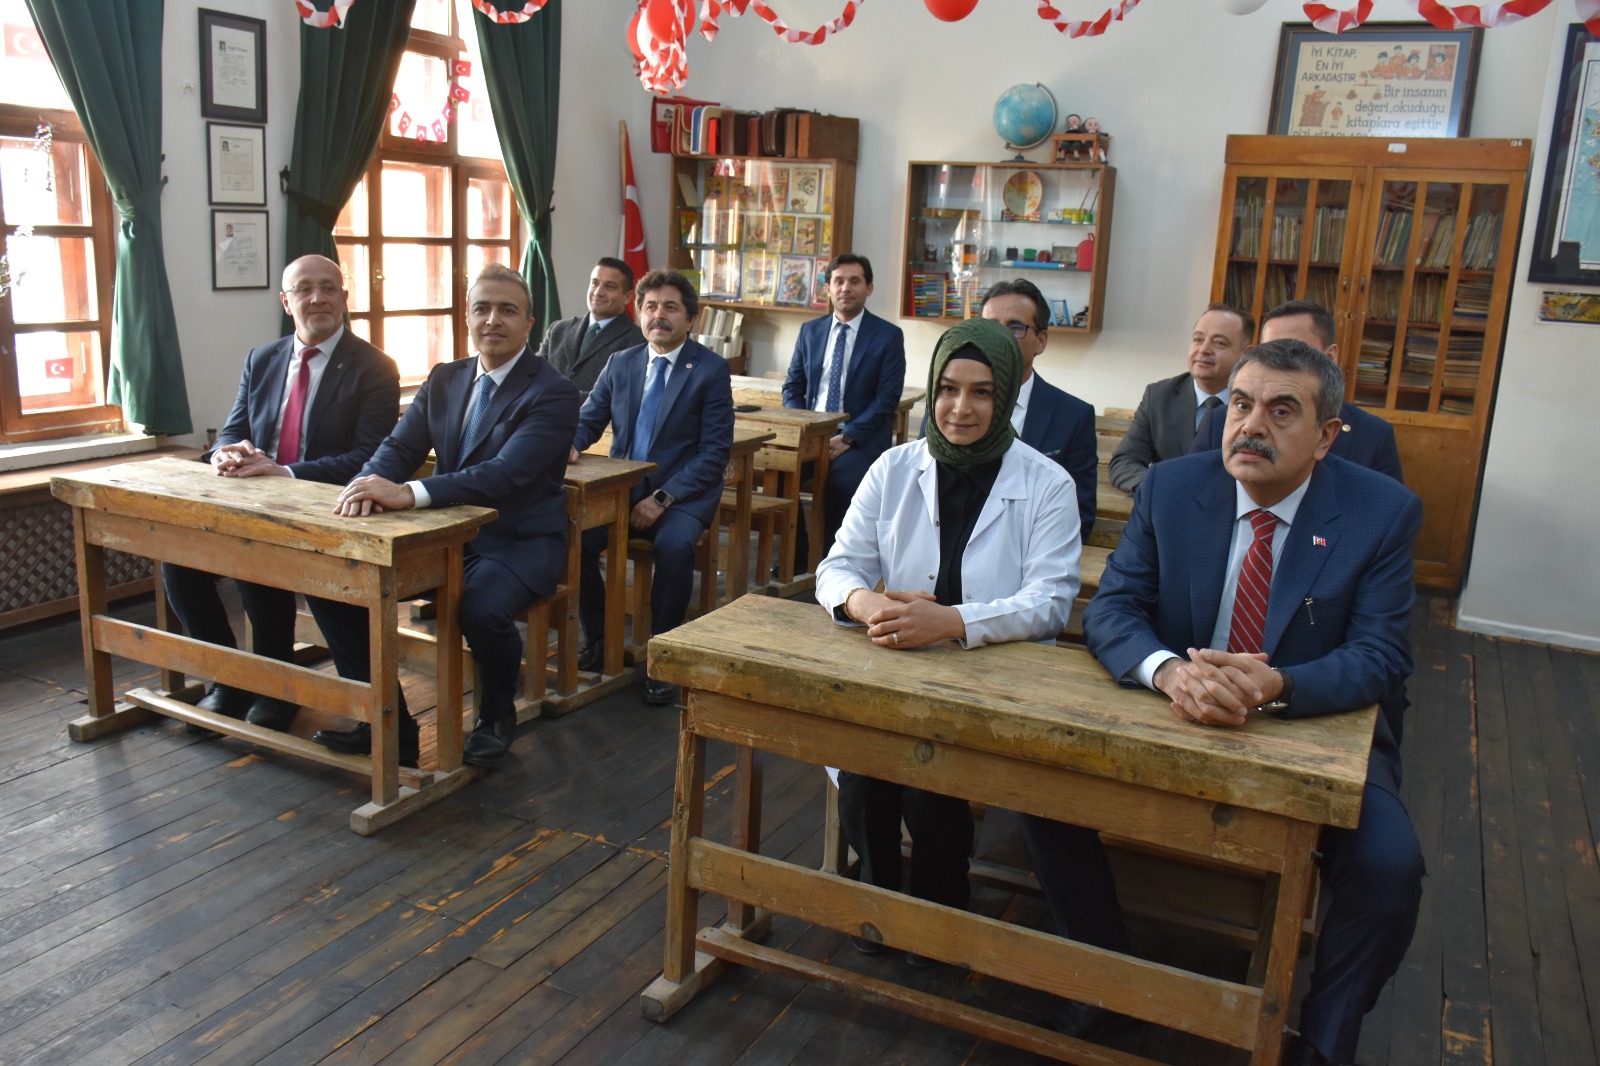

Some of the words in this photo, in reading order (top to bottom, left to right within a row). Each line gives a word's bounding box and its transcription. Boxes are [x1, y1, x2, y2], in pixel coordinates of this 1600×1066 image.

[1311, 46, 1322, 57] İYİ
[1316, 60, 1329, 71] EN
[1332, 59, 1344, 71] İYİ
[1301, 72, 1357, 83] ARKADAŞTIR
[1384, 85, 1400, 98] Bir
[1403, 86, 1447, 98] insanın
[1393, 100, 1445, 117] okuduğu
[1346, 115, 1400, 132] kitaplara
